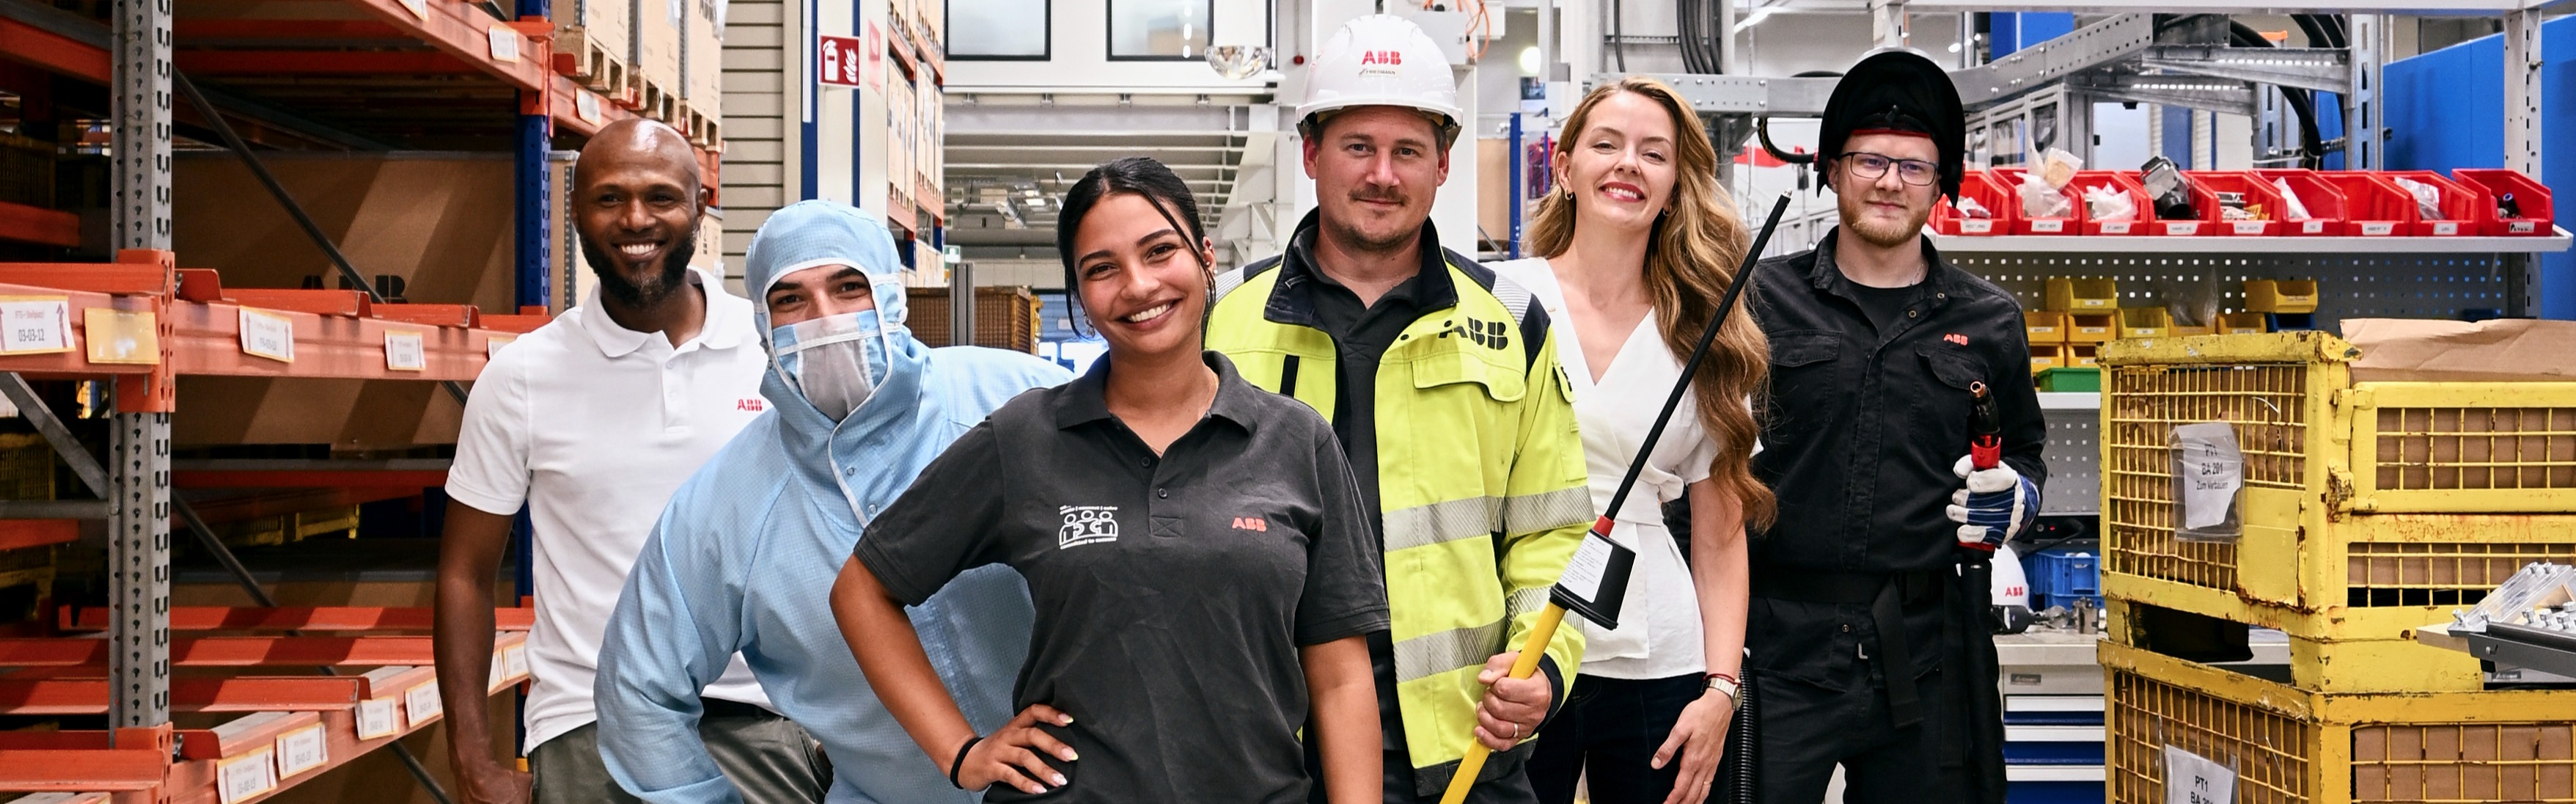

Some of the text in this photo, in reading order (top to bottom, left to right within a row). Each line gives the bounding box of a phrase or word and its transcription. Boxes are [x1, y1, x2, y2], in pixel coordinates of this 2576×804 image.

[1362, 50, 1402, 65] ABB
[18, 329, 45, 342] 03-03-12
[1439, 316, 1508, 350] ABB
[1943, 333, 1968, 346] ABB
[737, 398, 763, 412] ABB
[2201, 463, 2223, 475] BA 201
[2196, 480, 2207, 490] Zum
[1232, 516, 1266, 532] ABB
[2006, 587, 2023, 596] ABB
[2195, 775, 2208, 792] PT1
